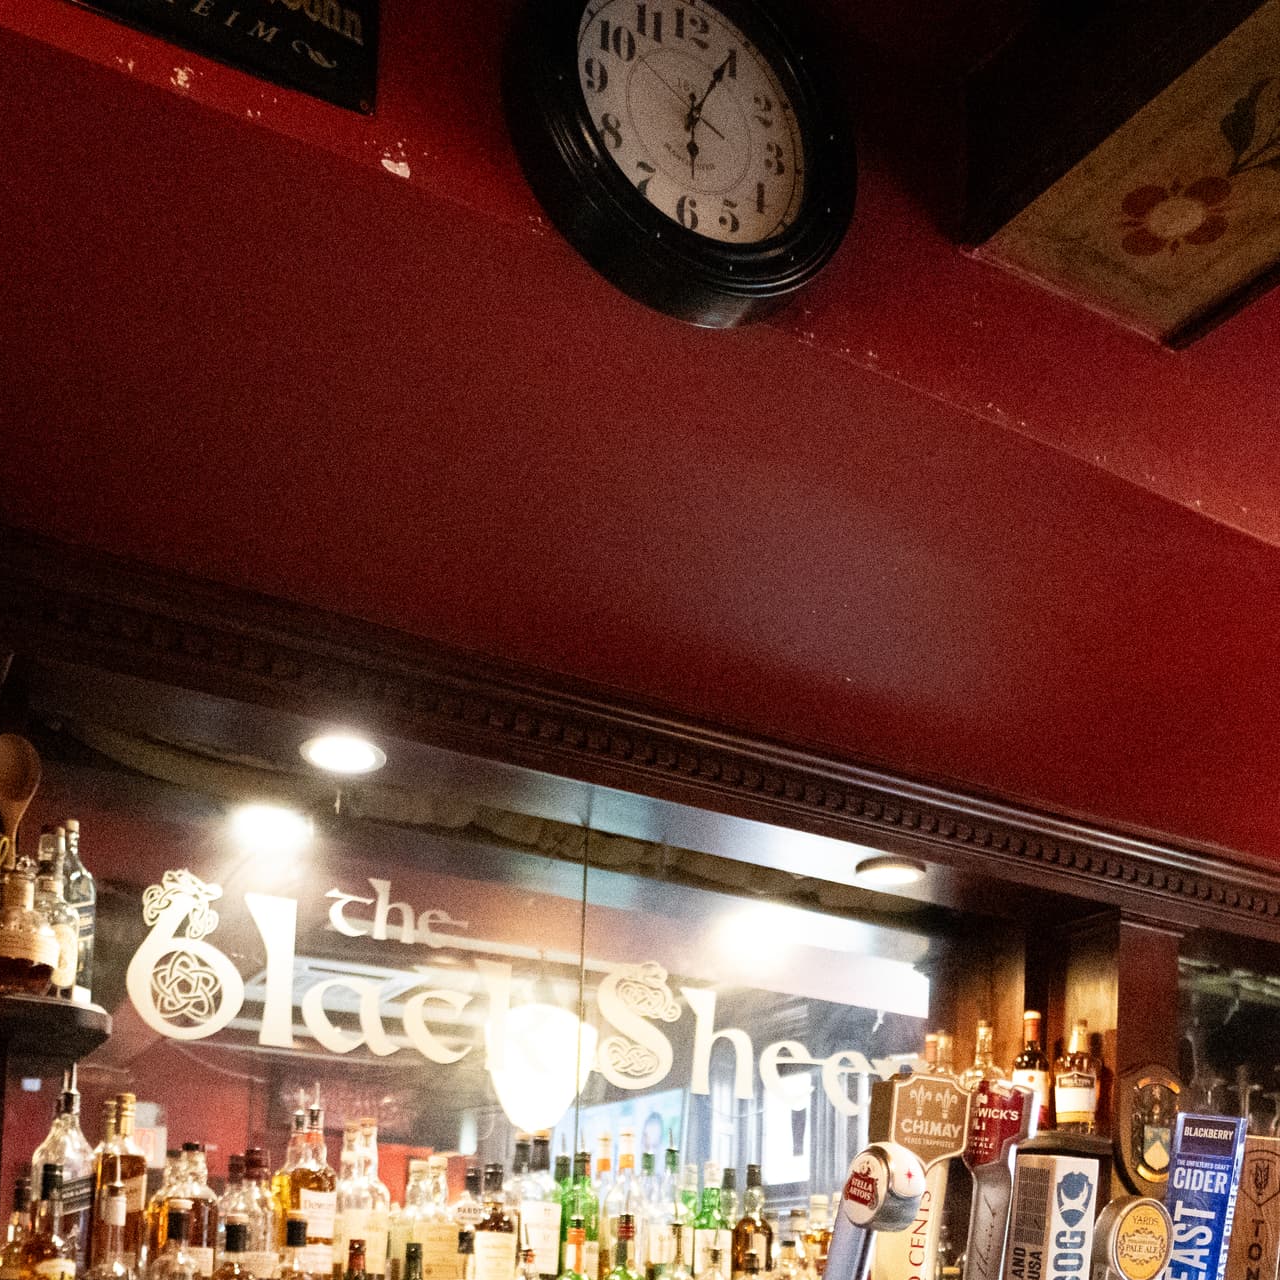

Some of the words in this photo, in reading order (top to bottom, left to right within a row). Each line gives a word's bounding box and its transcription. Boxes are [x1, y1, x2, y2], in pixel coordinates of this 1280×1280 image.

[600, 19, 636, 62] 10
[637, 2, 663, 44] 11
[674, 7, 710, 50] 12
[584, 57, 609, 94] 9
[754, 94, 774, 129] 2
[597, 112, 623, 150] 8
[765, 142, 786, 177] 3
[635, 160, 657, 200] 7
[676, 195, 699, 231] 6
[718, 198, 740, 233] 5
[325, 877, 470, 949] the
[900, 1118, 963, 1138] CHIMAY
[974, 1109, 1020, 1122] WICK'S
[1183, 1125, 1235, 1142] BLACKBERRY
[848, 1186, 872, 1202] ARTOIS
[850, 1178, 874, 1193] STELLA
[1172, 1166, 1228, 1195] CIDER
[1131, 1215, 1160, 1226] YARDS
[1223, 1183, 1239, 1237] CIDER
[908, 1189, 932, 1267] CENTS
[1125, 1243, 1143, 1254] PALE
[1144, 1243, 1160, 1254] ALE
